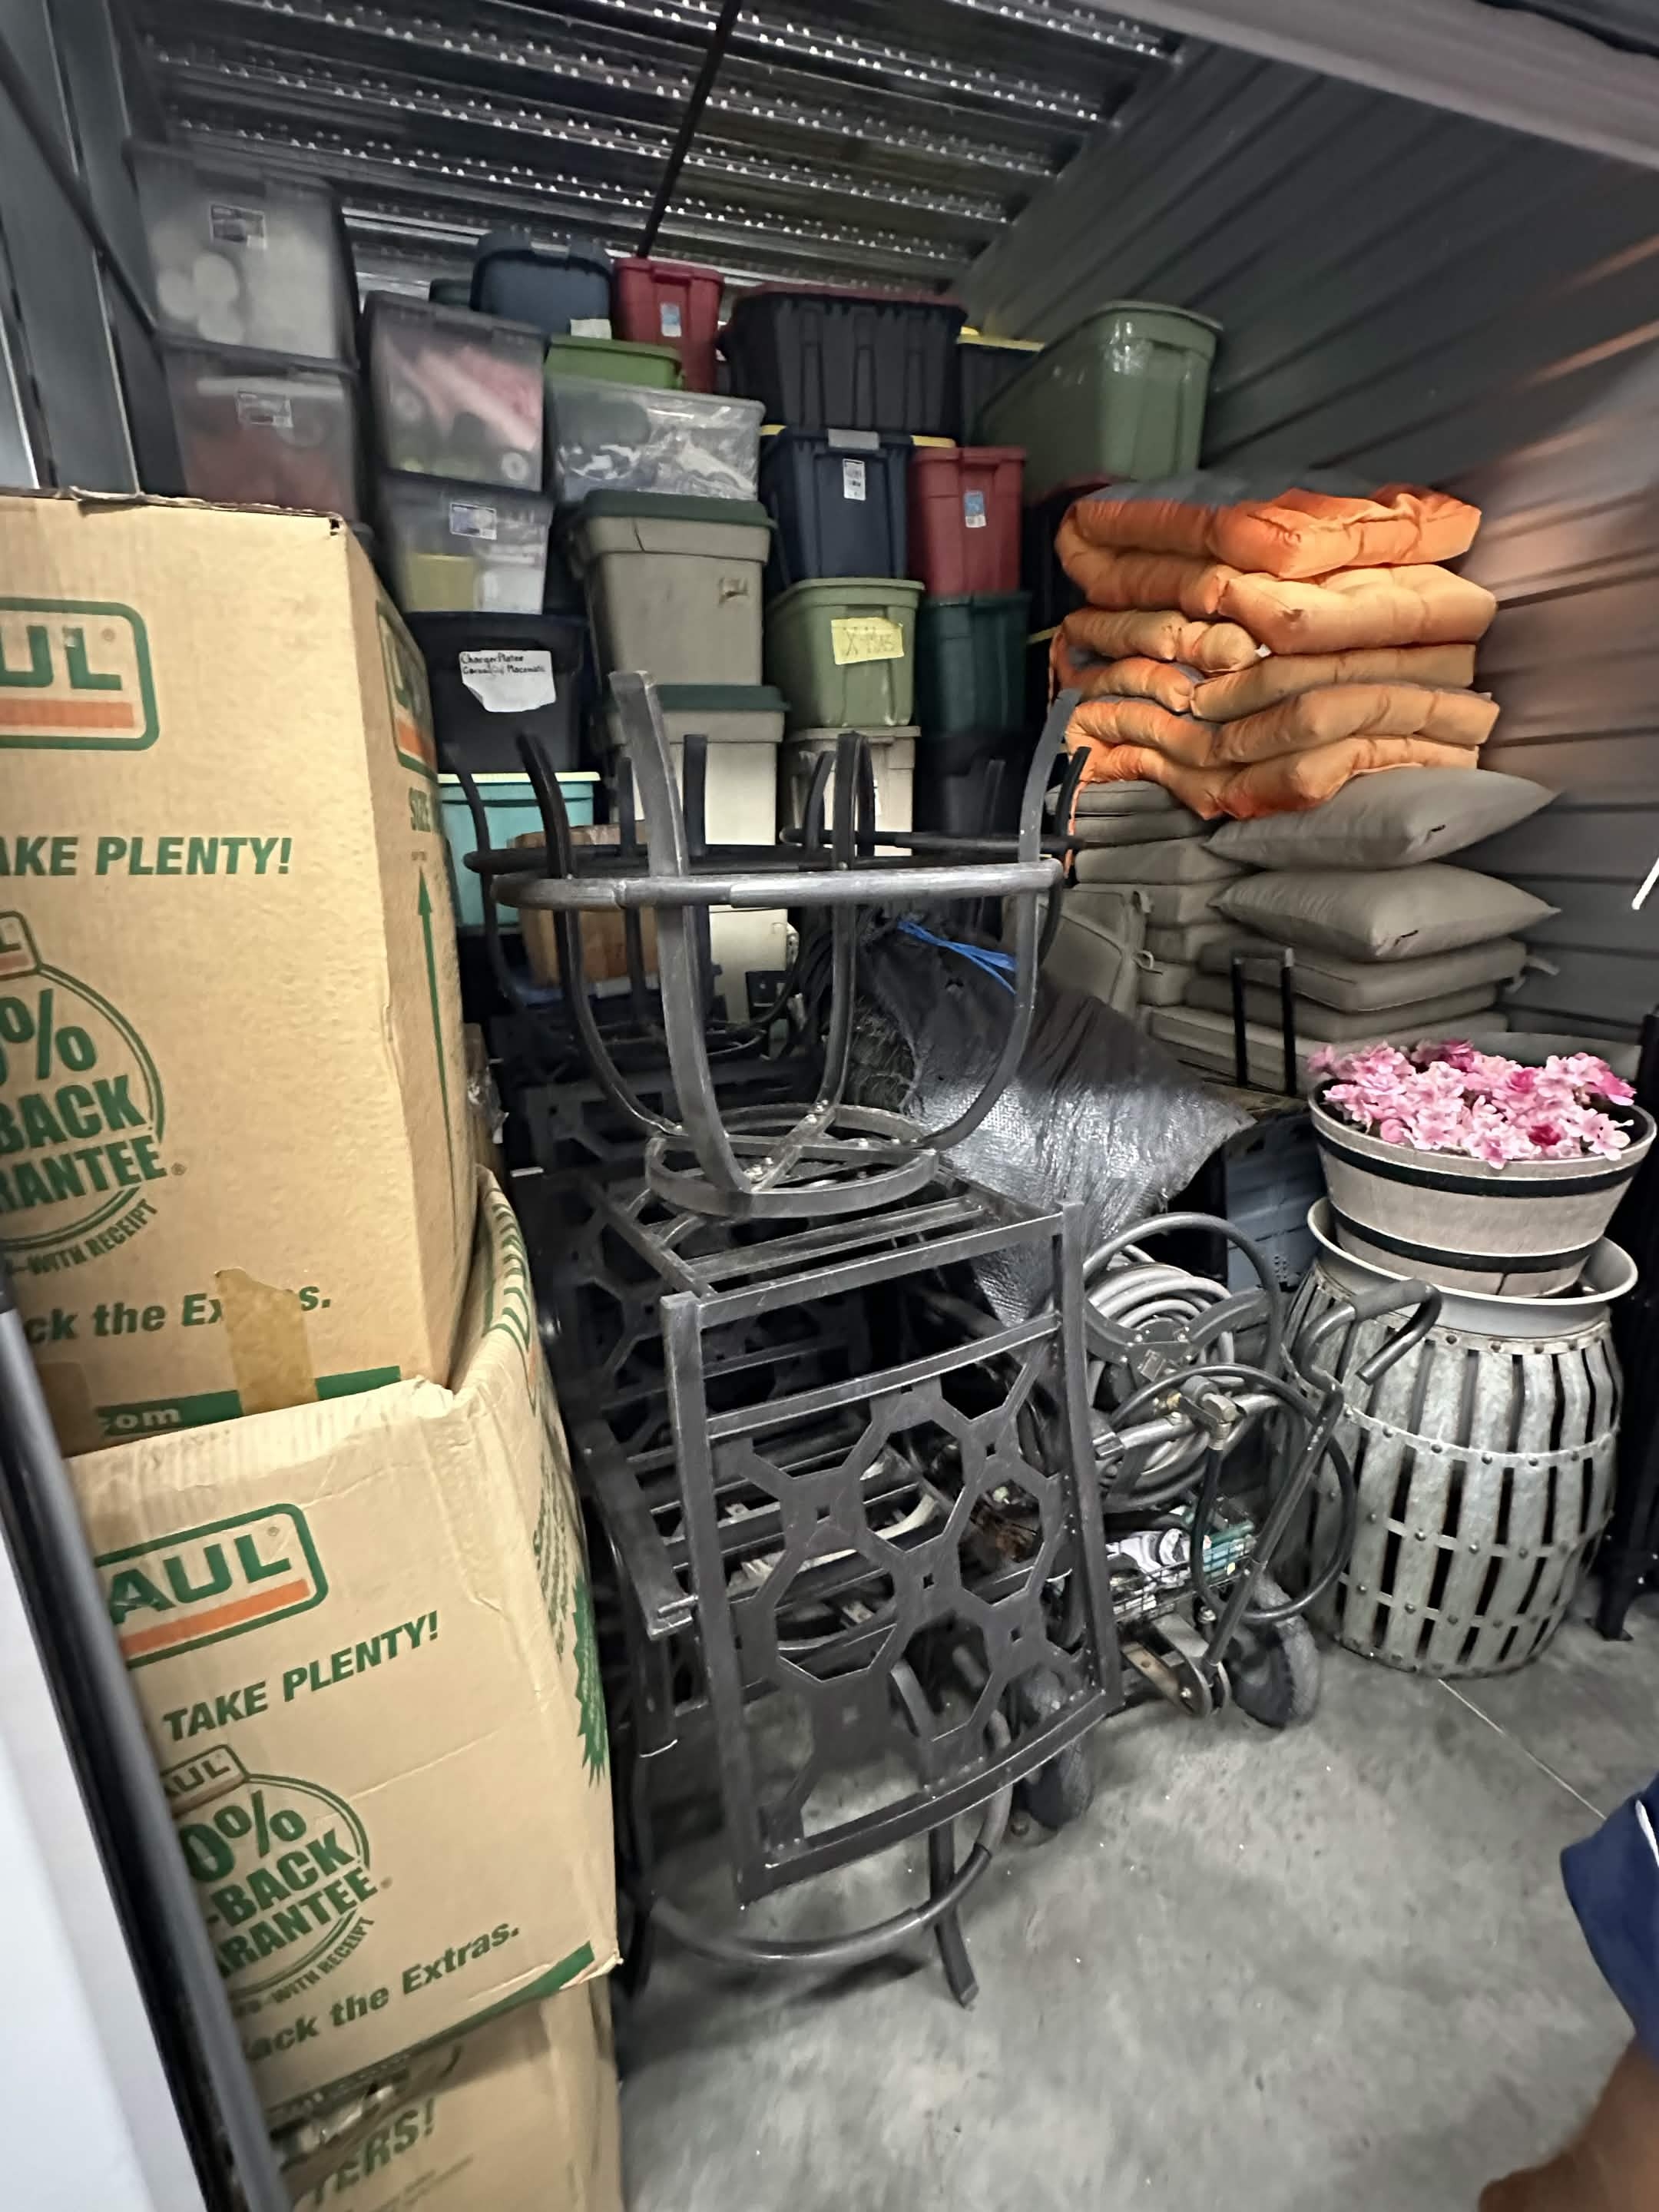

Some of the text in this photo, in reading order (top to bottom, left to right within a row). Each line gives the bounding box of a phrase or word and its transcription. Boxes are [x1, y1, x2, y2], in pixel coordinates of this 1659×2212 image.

[94, 837, 292, 876] PLENTY!
[84, 1199, 157, 1257] RECEIPT
[25, 1308, 78, 1343] ck
[94, 1303, 166, 1338] the
[163, 1610, 438, 1741] TAKE PLENTY!
[317, 1916, 376, 1975] RECEIPT
[243, 1922, 520, 2062] ack the Extras.
